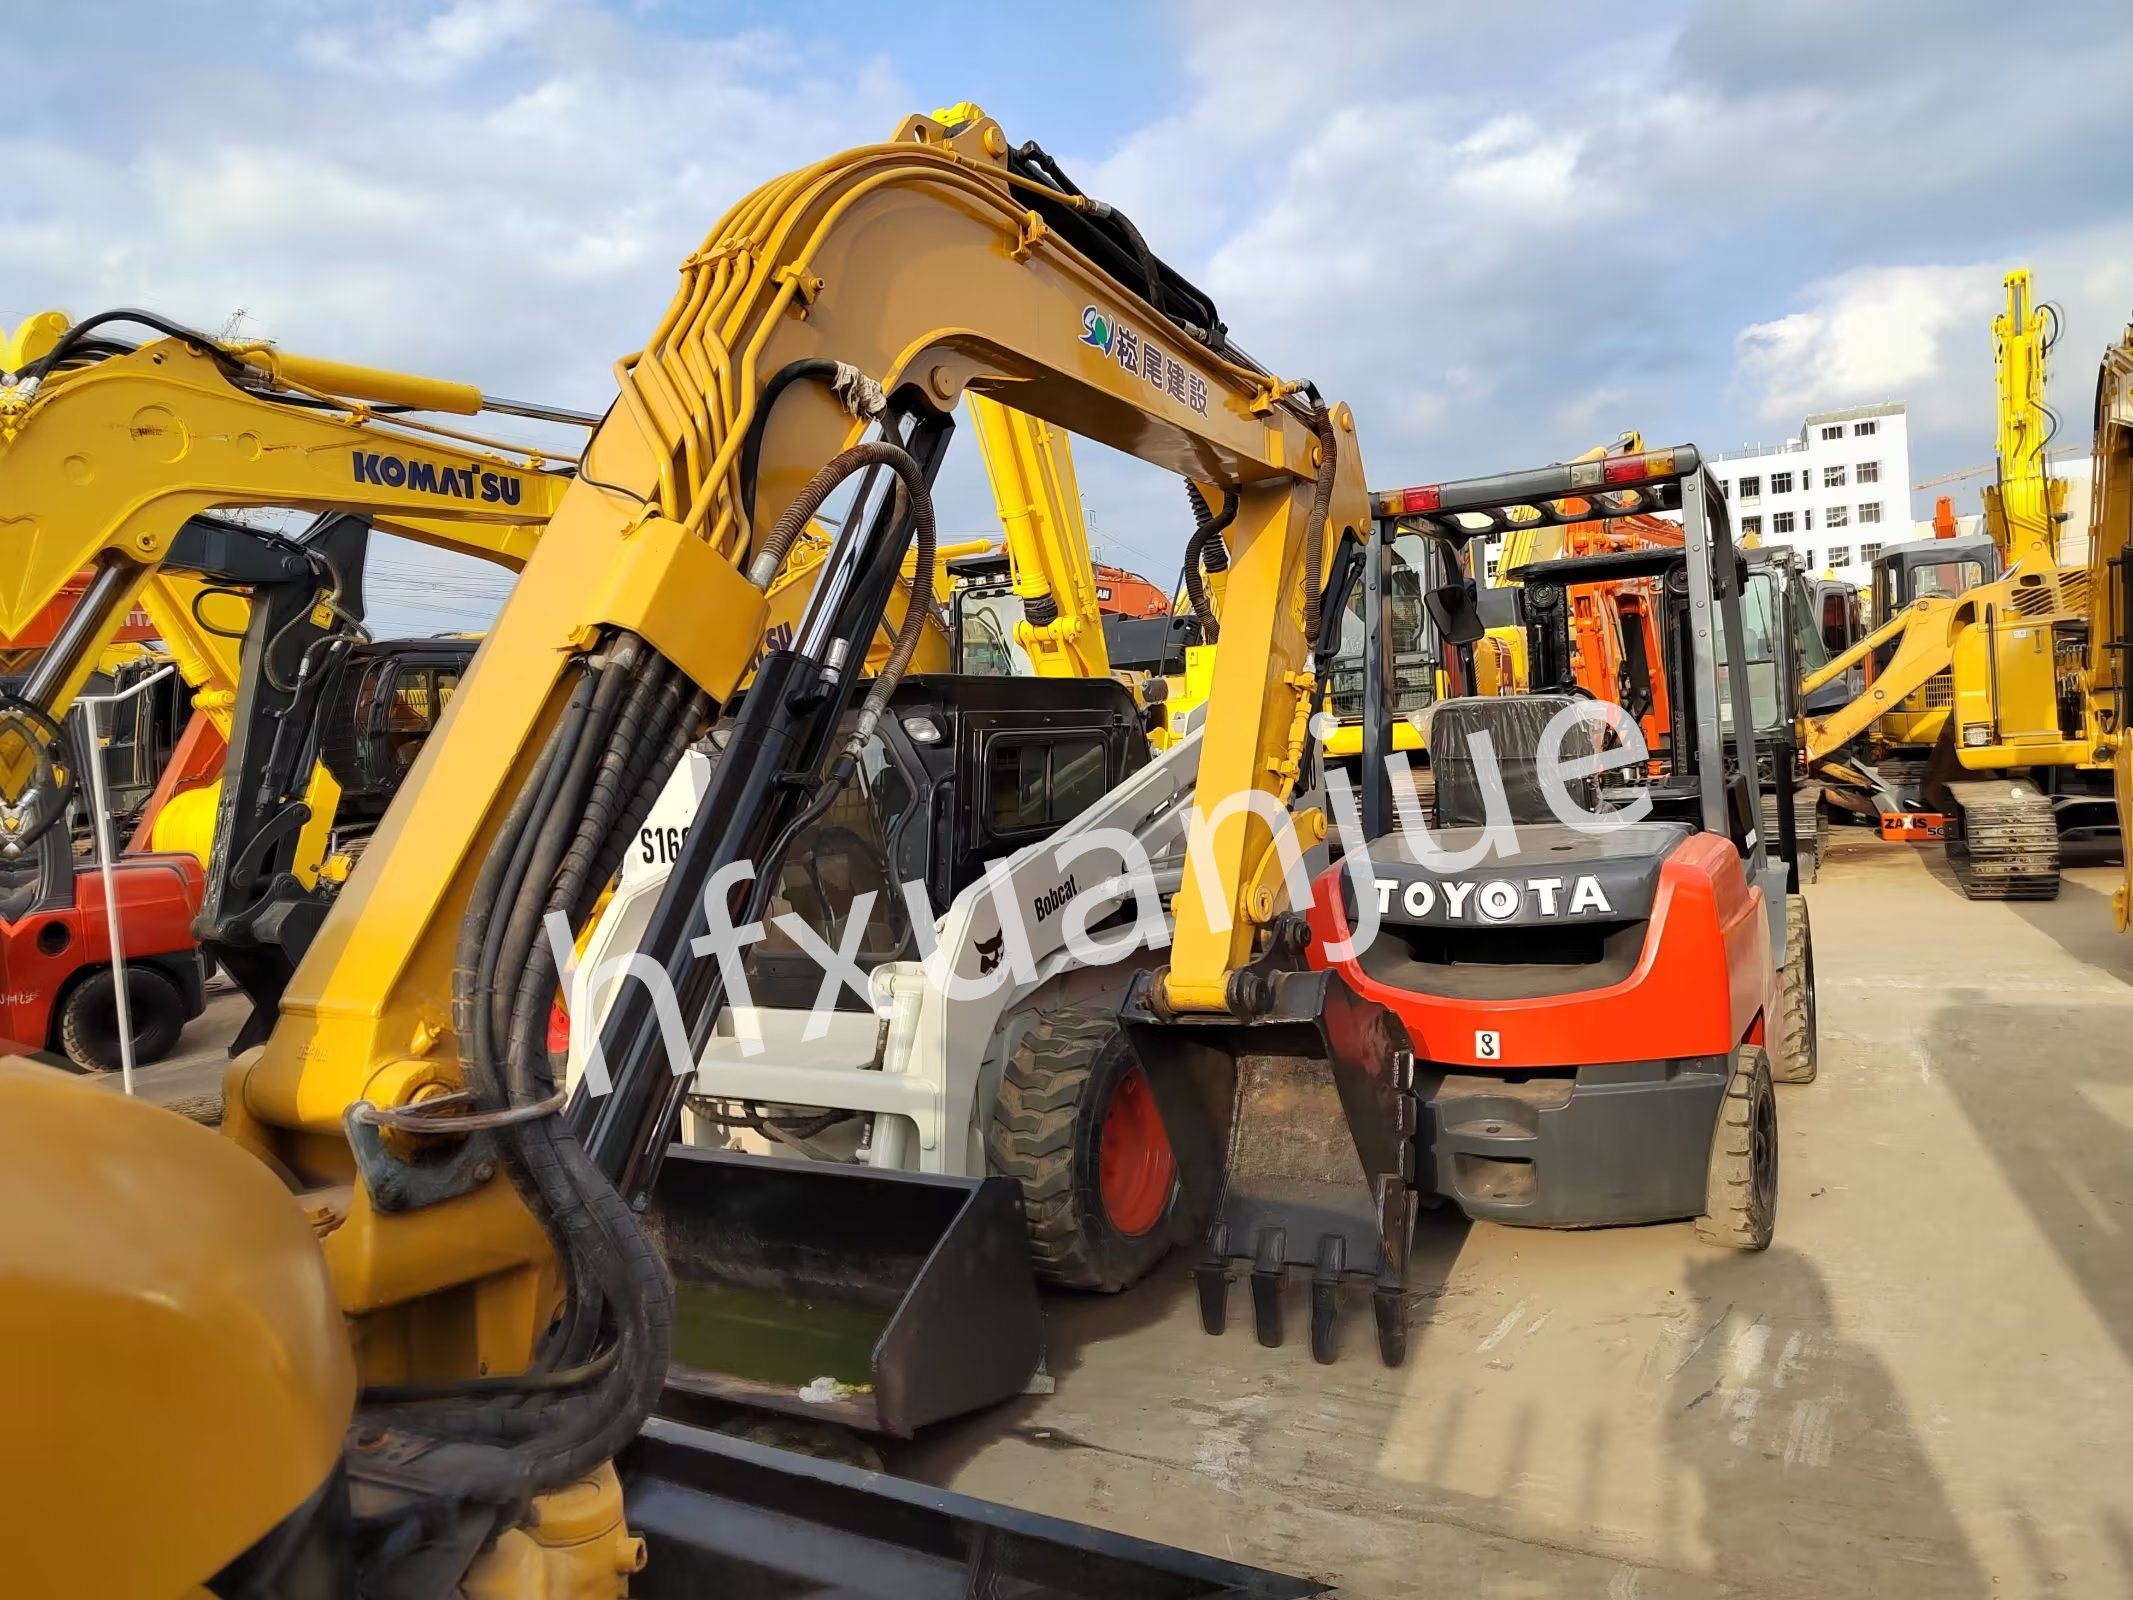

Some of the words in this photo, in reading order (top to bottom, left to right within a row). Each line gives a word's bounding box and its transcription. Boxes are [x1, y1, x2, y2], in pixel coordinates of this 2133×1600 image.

[352, 450, 521, 506] KOMATSU
[1884, 815, 1928, 830] ZAXIS
[1033, 873, 1078, 923] Bobcat
[1373, 875, 1615, 920] TOYOTA
